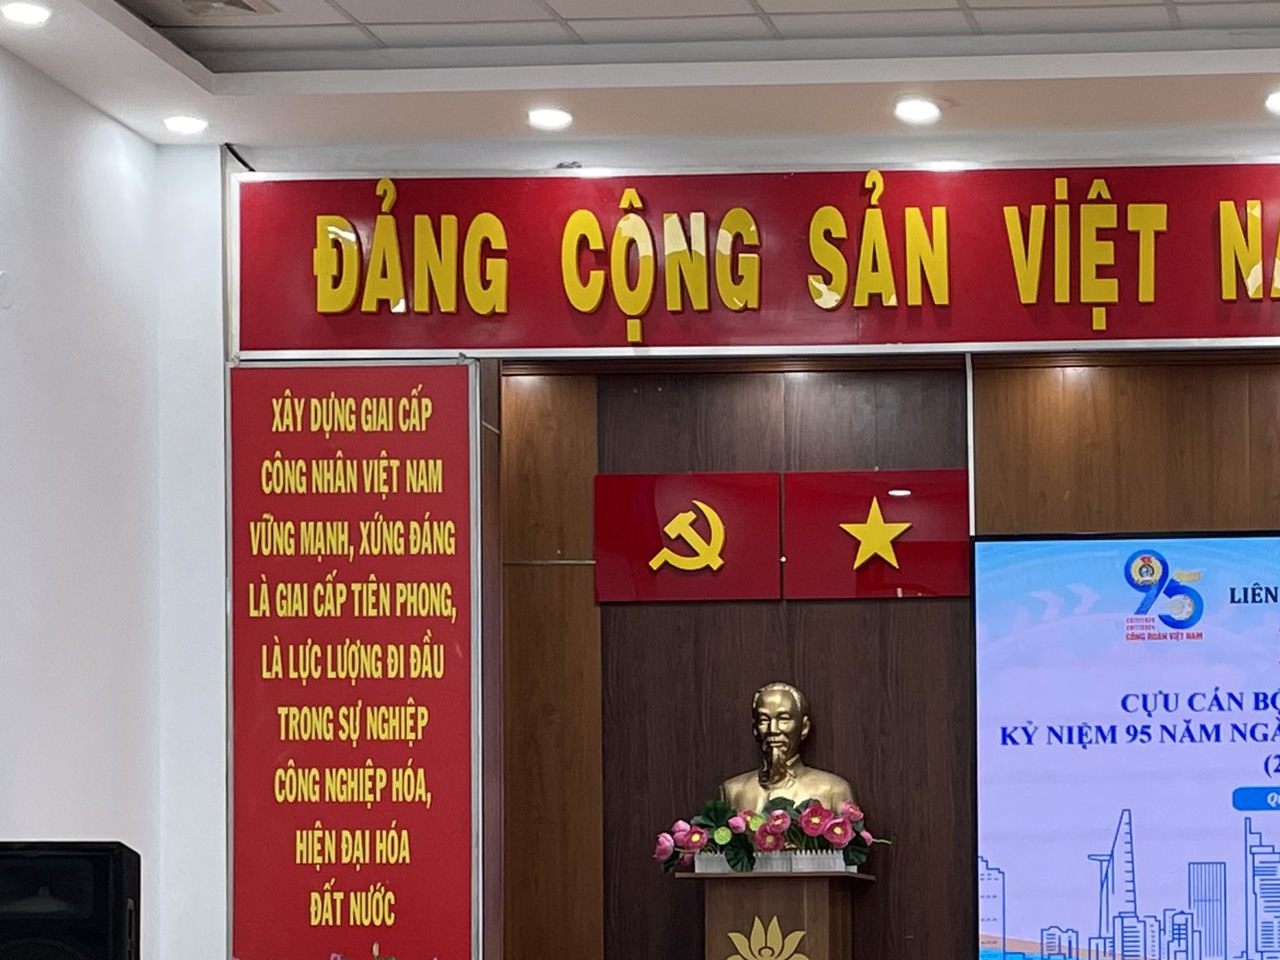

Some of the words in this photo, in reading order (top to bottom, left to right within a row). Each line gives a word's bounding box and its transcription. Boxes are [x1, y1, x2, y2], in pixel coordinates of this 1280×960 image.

[312, 178, 509, 315] ĐẢNG
[561, 189, 761, 343] CỘNG
[808, 169, 950, 309] SẢN
[272, 389, 305, 432] XÂY
[311, 392, 356, 439] DỰNG
[361, 398, 393, 432] GIAI
[399, 384, 432, 432] CẤP
[262, 451, 306, 494] CÔNG
[312, 450, 357, 493] NHÂN
[362, 450, 400, 500] VIỆT
[406, 459, 442, 493] NAM
[250, 513, 295, 555] VỮNG
[300, 522, 354, 562] MẠNH,
[360, 512, 404, 555] XỨNG
[409, 512, 455, 555] ĐÁNG
[249, 574, 270, 617] LÀ
[276, 583, 308, 617] GIAI
[313, 569, 347, 617] CẤP
[351, 574, 390, 616] TIÊN
[396, 582, 456, 623] PHONG,
[1229, 582, 1278, 604] LIÊN
[262, 636, 282, 678] LÀ
[289, 638, 321, 686] LỰC
[327, 638, 382, 686] LƯỢNG
[387, 645, 404, 678] ĐI
[410, 629, 444, 678] ĐẦU
[278, 706, 333, 740] TRONG
[338, 700, 362, 747] SỰ
[367, 697, 428, 747] NGHIỆP
[1187, 687, 1244, 713] CÁN
[1000, 720, 1039, 746] KỶ
[1125, 724, 1152, 744] 95
[1159, 719, 1223, 744] NĂM
[275, 759, 319, 802] CÔNG
[325, 759, 387, 809] NGHIỆP
[392, 758, 431, 808] HÓA,
[296, 821, 336, 871] HIỆN
[341, 830, 369, 871] ĐẠI
[376, 820, 410, 864] HÓA
[310, 878, 344, 925] ĐẤT
[350, 882, 395, 926] NƯỚC
